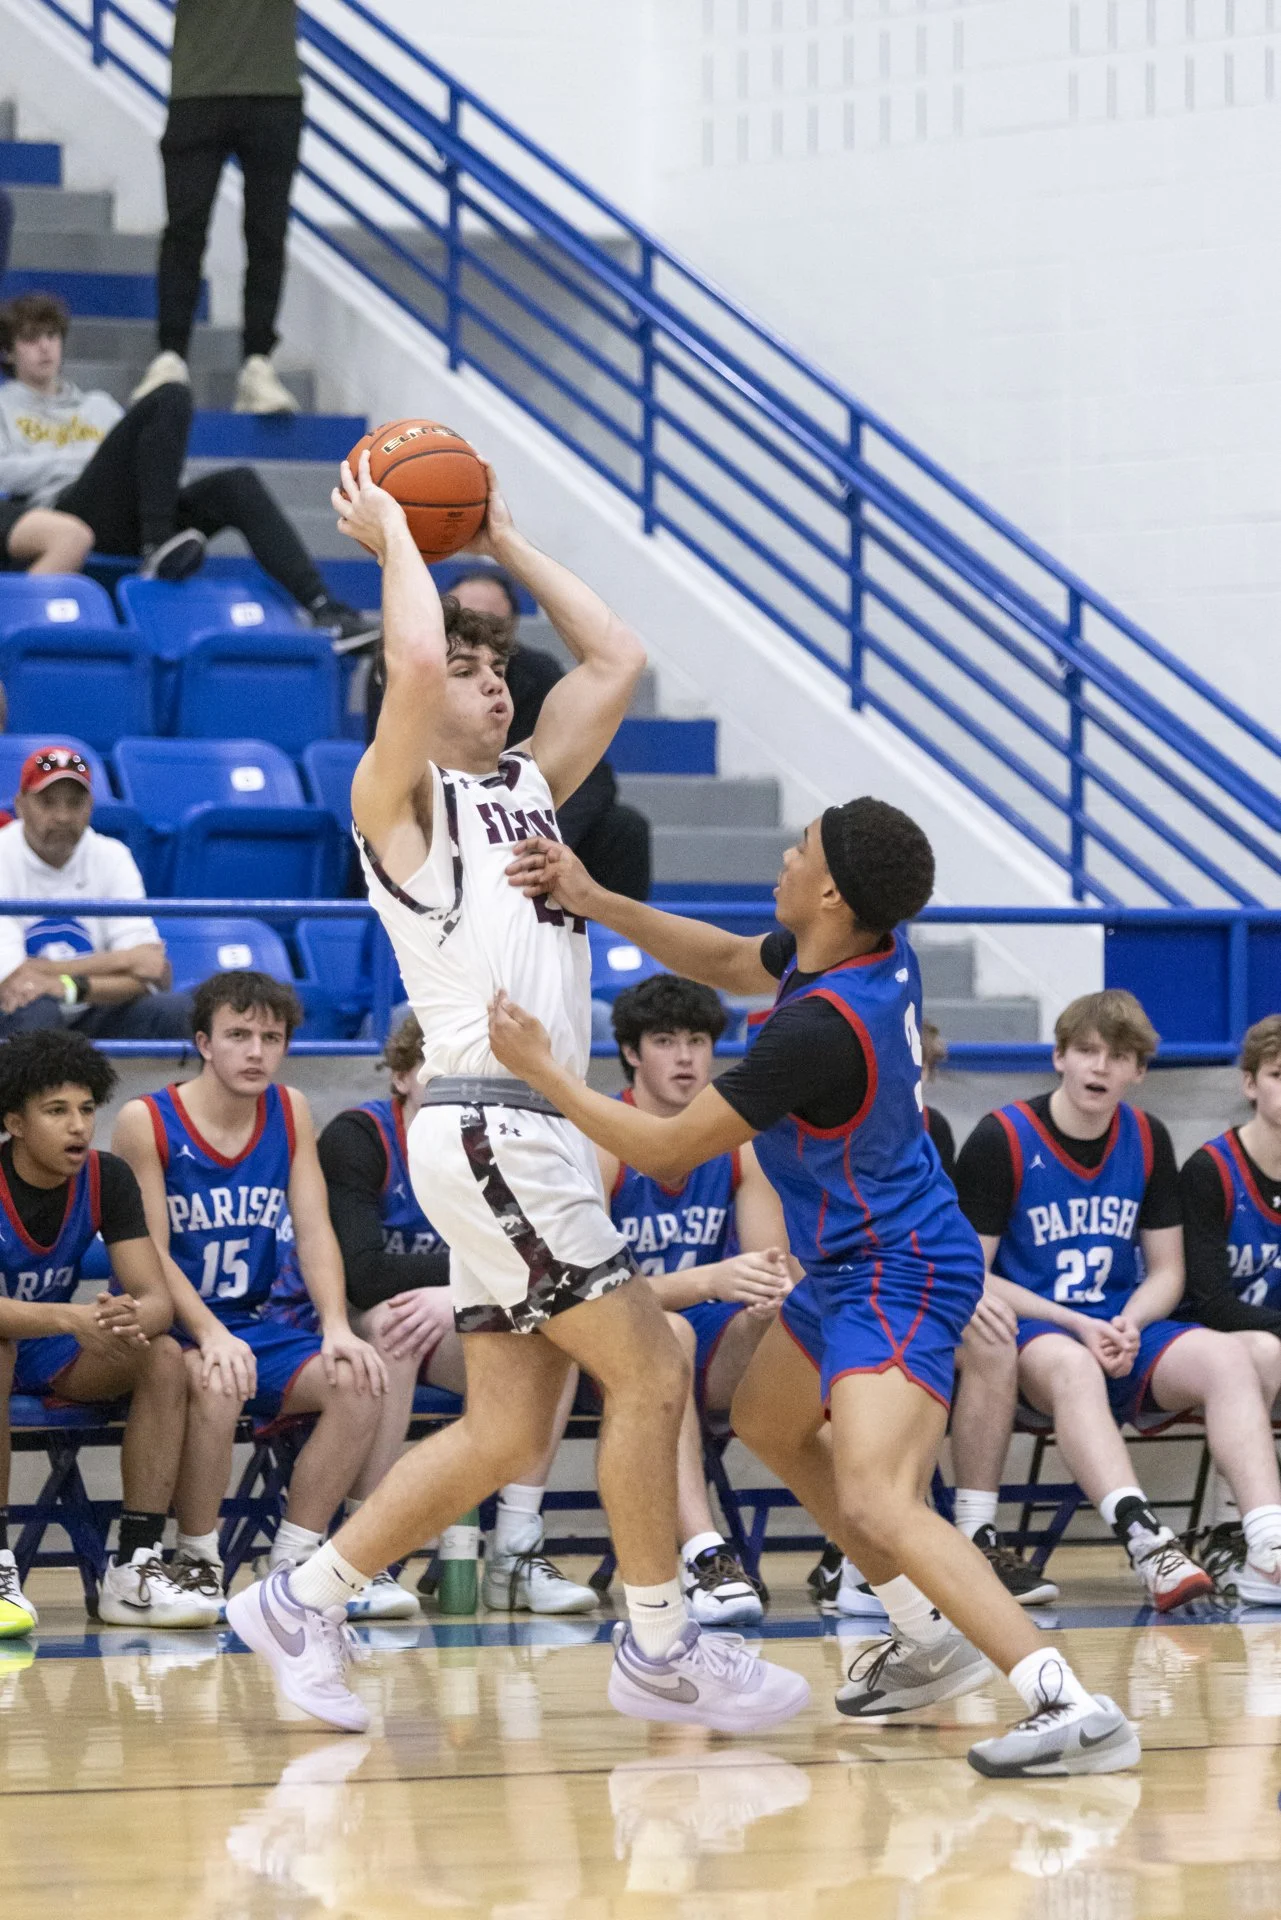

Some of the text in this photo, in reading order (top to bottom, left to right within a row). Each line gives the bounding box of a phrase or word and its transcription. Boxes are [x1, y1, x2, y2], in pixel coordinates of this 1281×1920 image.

[166, 1186, 285, 1233] PARISH
[1027, 1196, 1139, 1247] PARISH
[200, 1239, 249, 1299] 15
[1054, 1246, 1113, 1303] 23
